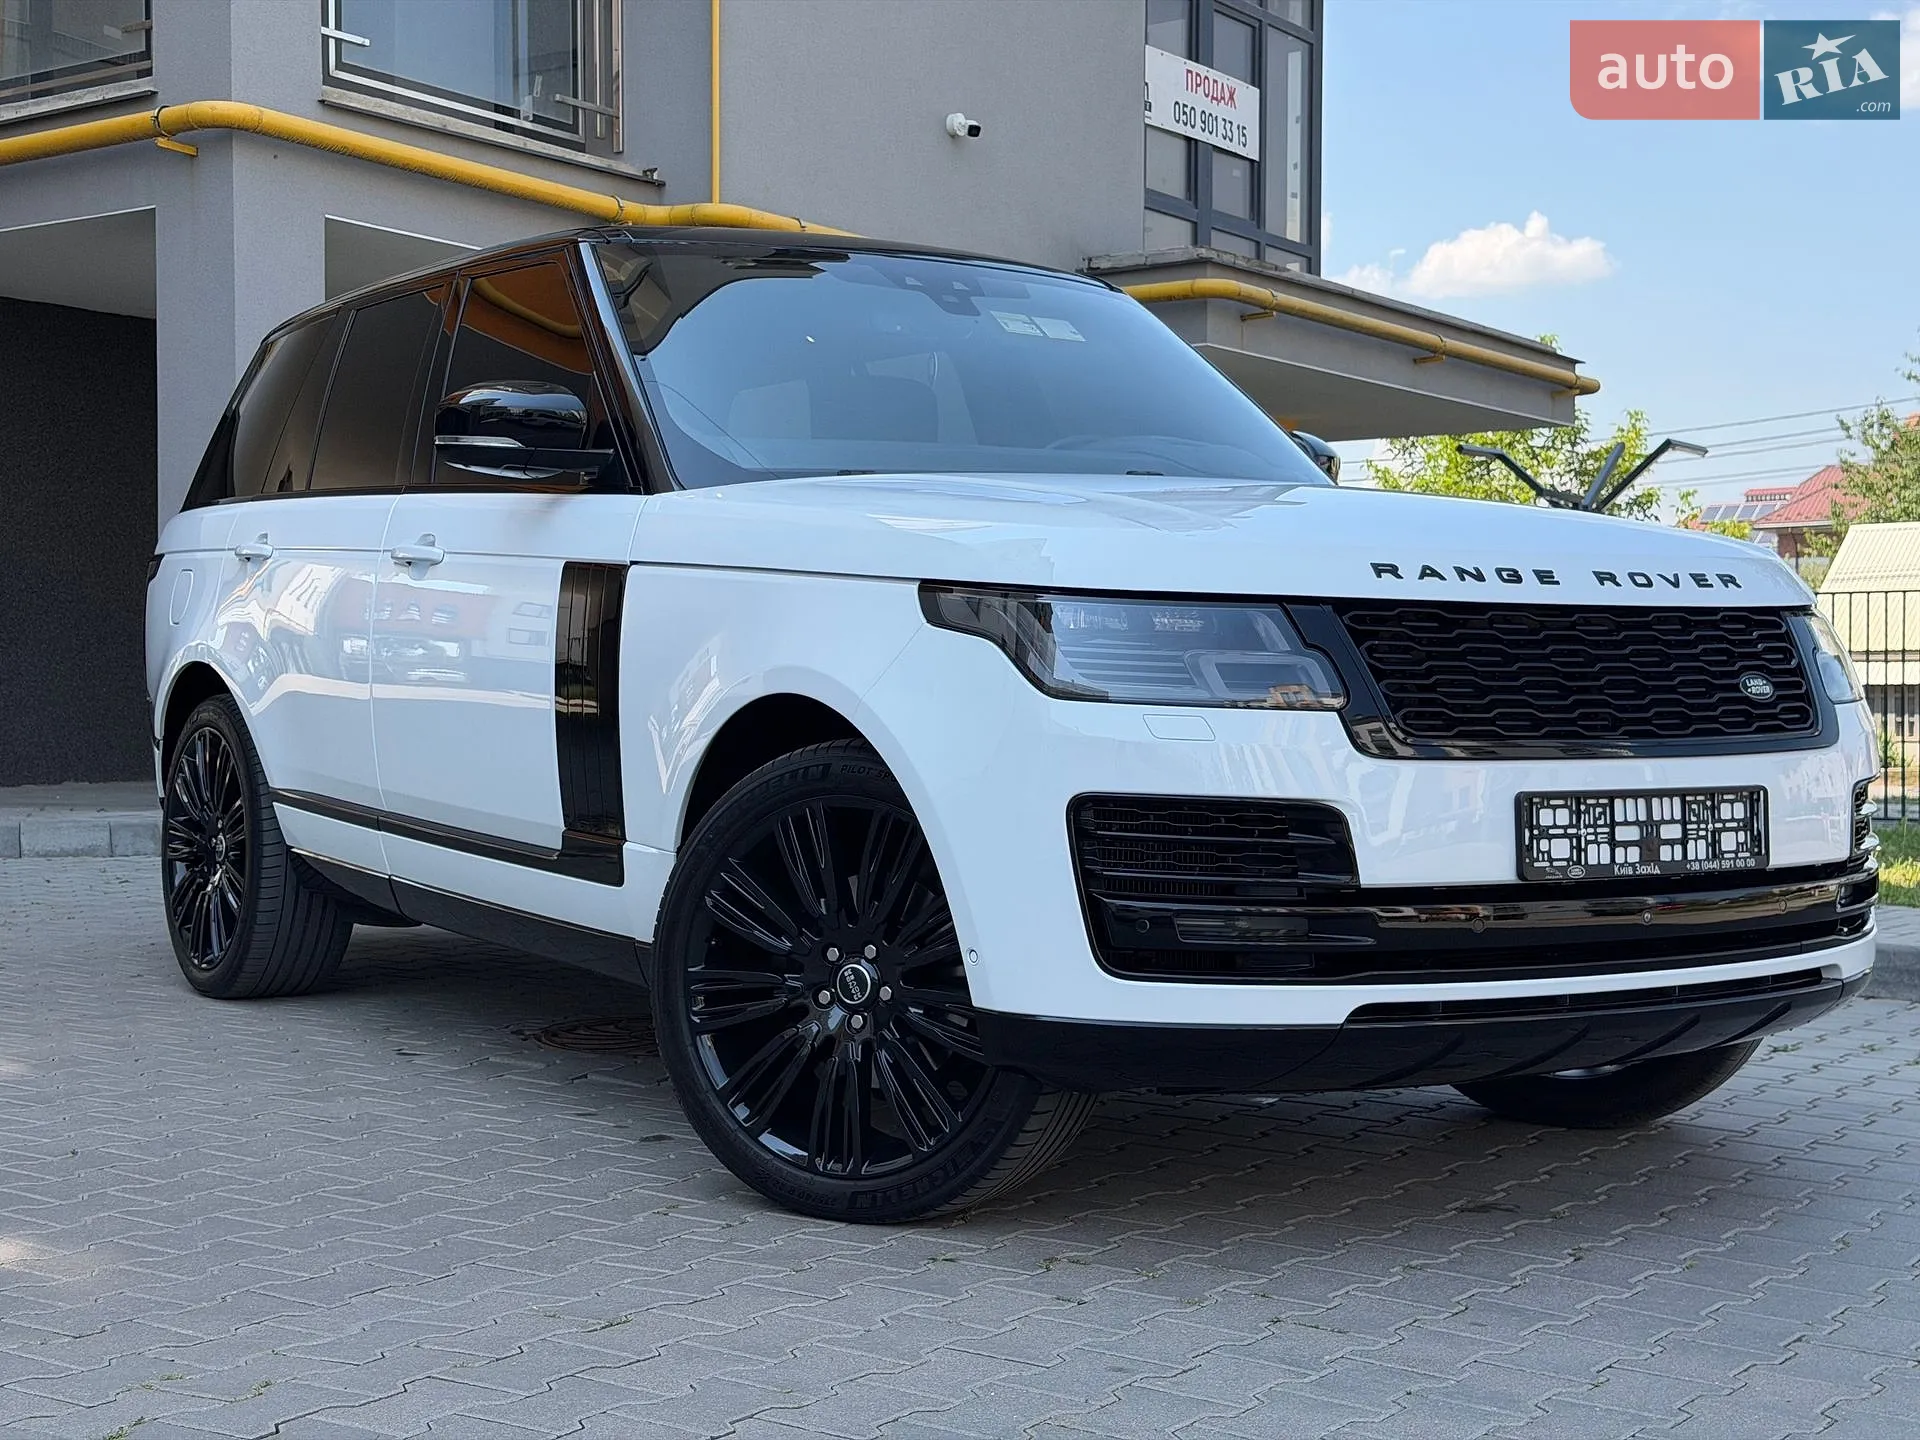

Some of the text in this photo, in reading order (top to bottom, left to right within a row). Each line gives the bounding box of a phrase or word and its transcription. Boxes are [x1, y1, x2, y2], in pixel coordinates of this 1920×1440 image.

[1185, 68, 1237, 110] ПРОДАЖ
[1173, 100, 1197, 129] 050
[1200, 109, 1219, 138] 901
[1221, 117, 1234, 143] 33
[1236, 123, 1248, 148] 15
[1369, 562, 1743, 589] RANGE ROVER
[840, 764, 874, 776] PILOT
[1614, 863, 1633, 875] Київ
[1686, 861, 1700, 871] +38
[1701, 859, 1720, 871] (044)
